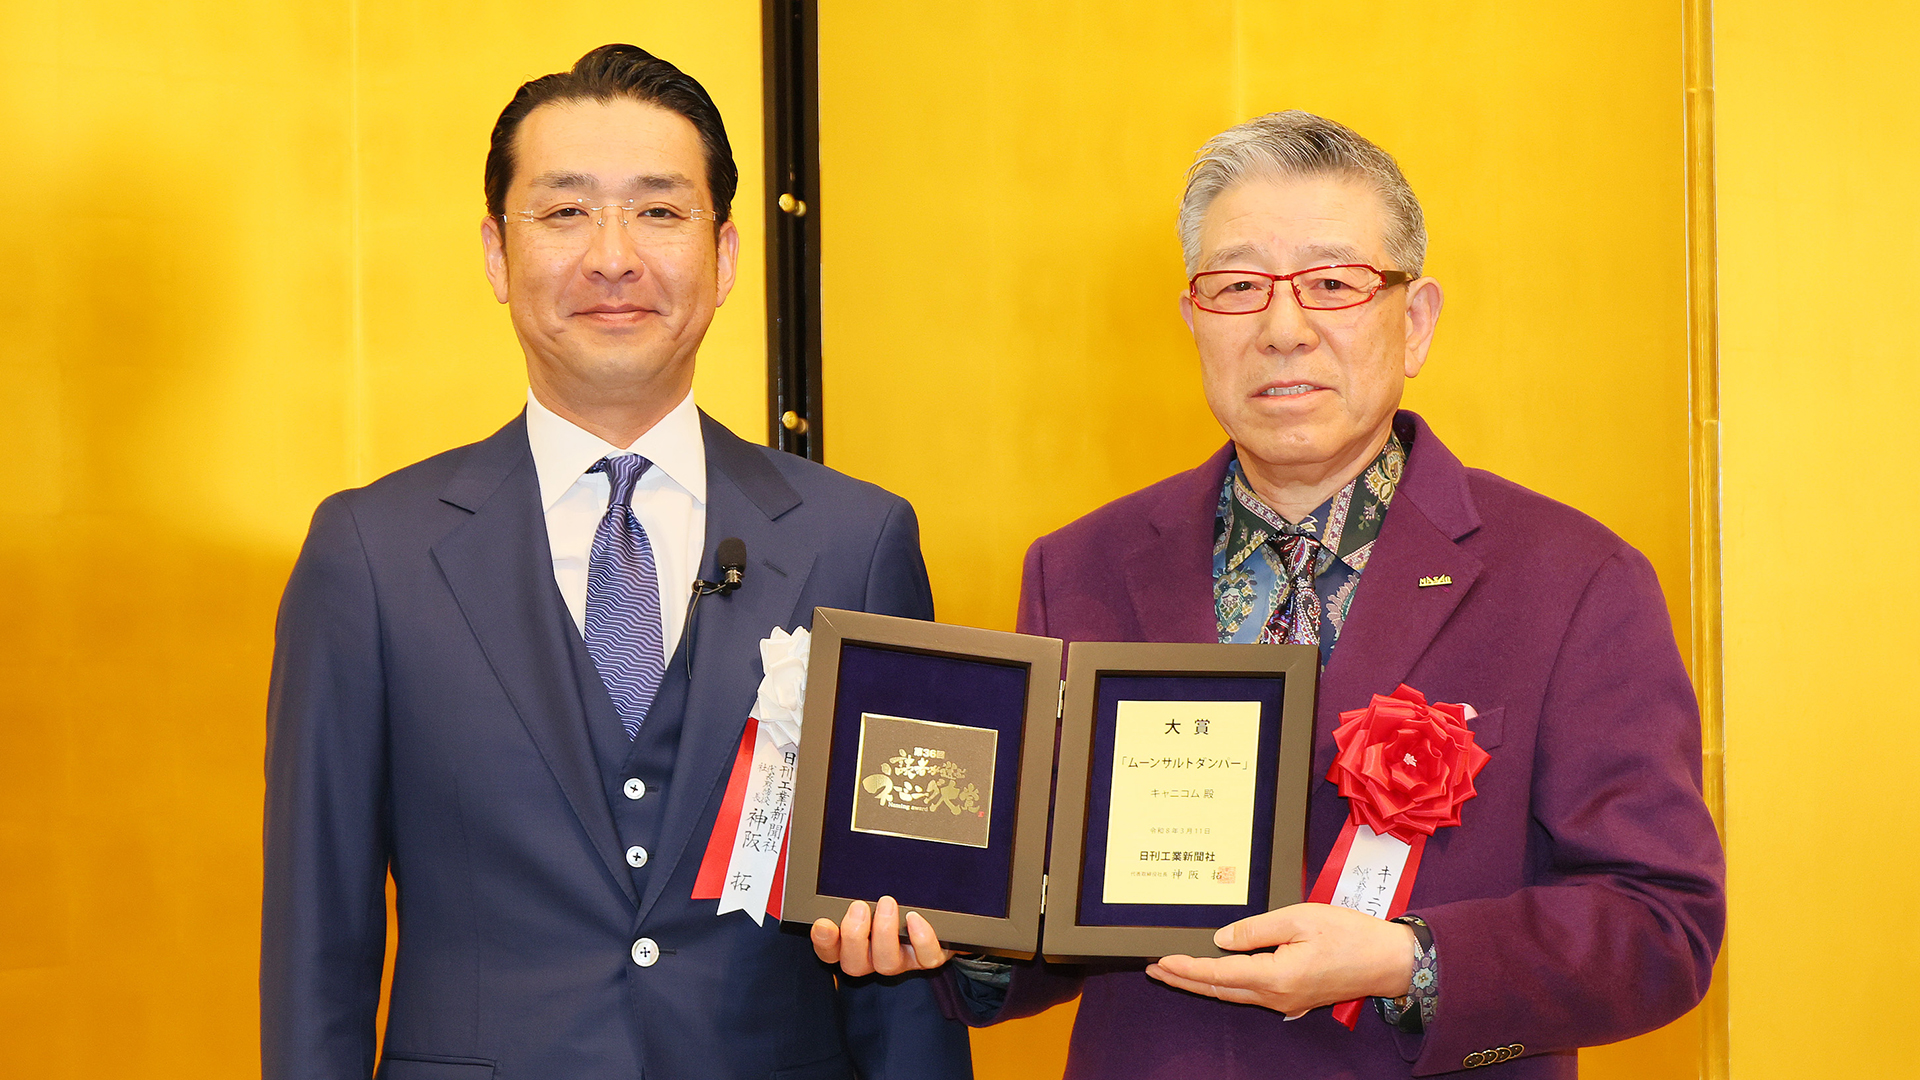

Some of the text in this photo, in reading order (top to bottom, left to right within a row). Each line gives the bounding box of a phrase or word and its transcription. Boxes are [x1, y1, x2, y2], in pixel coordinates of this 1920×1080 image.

[1165, 718, 1210, 735] 大賞
[1121, 756, 1248, 770] 「ムーンサルトダンパー」
[1151, 788, 1200, 799] キャニコム
[763, 751, 796, 855] 日刊工業新聞社
[730, 807, 769, 892] 神阪 拓
[1139, 850, 1216, 862] 日刊工業新聞社
